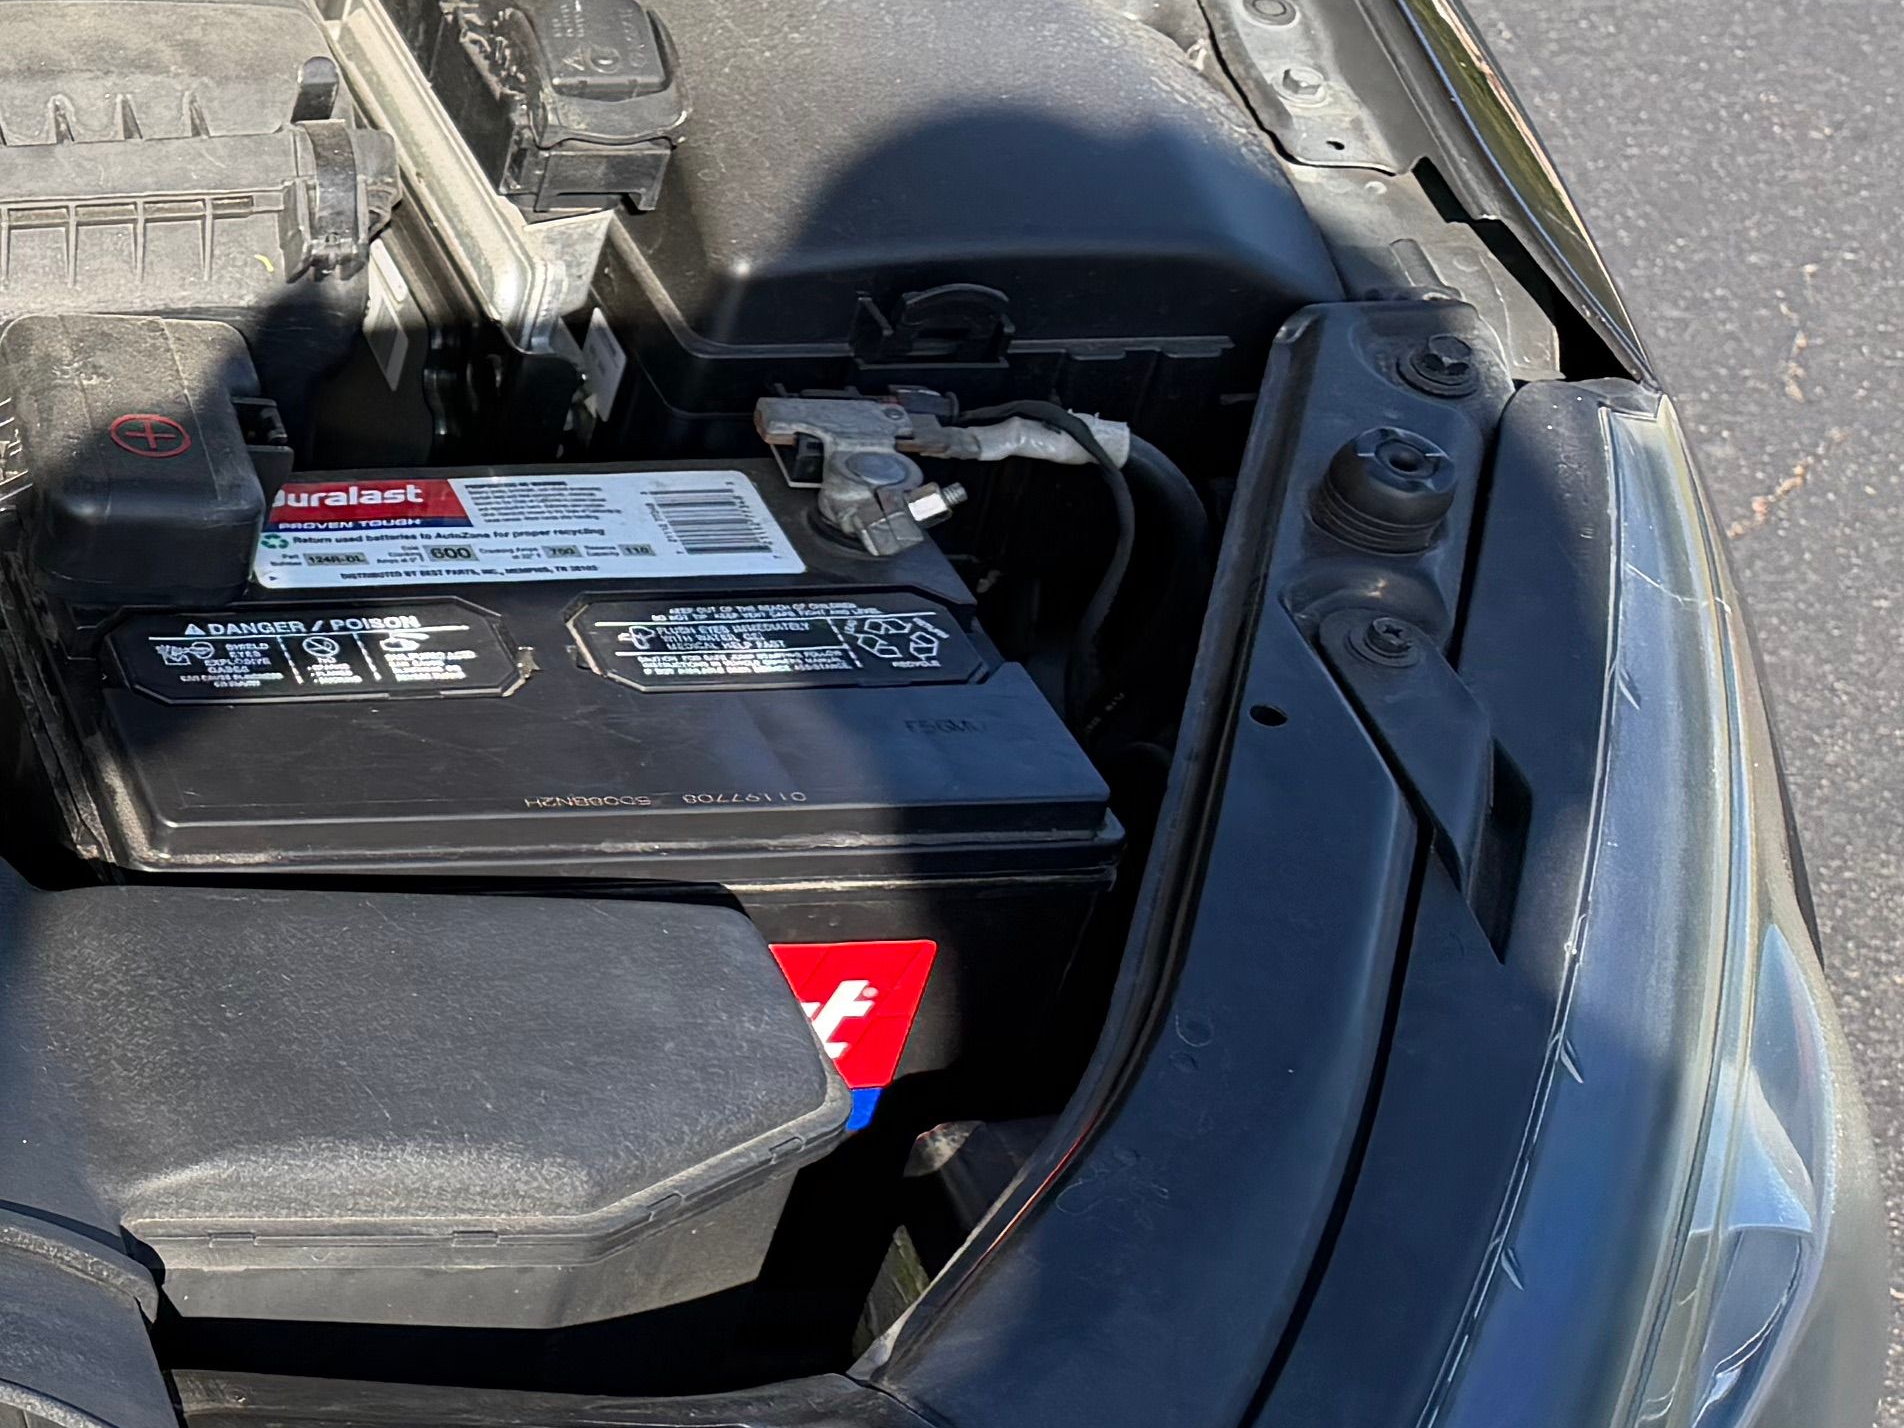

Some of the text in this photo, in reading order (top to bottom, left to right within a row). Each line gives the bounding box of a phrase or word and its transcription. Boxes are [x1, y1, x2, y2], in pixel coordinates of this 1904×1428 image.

[279, 518, 422, 530] PROVEN TOUGH
[293, 535, 332, 545] Return
[335, 535, 362, 543] used
[366, 533, 417, 542] batteries
[435, 531, 490, 540] AutoZone
[493, 531, 510, 539] for
[513, 529, 551, 539] proper
[553, 527, 605, 537] recycling
[430, 546, 473, 560] 600
[207, 621, 307, 635] DANGER
[329, 615, 422, 631] POISON
